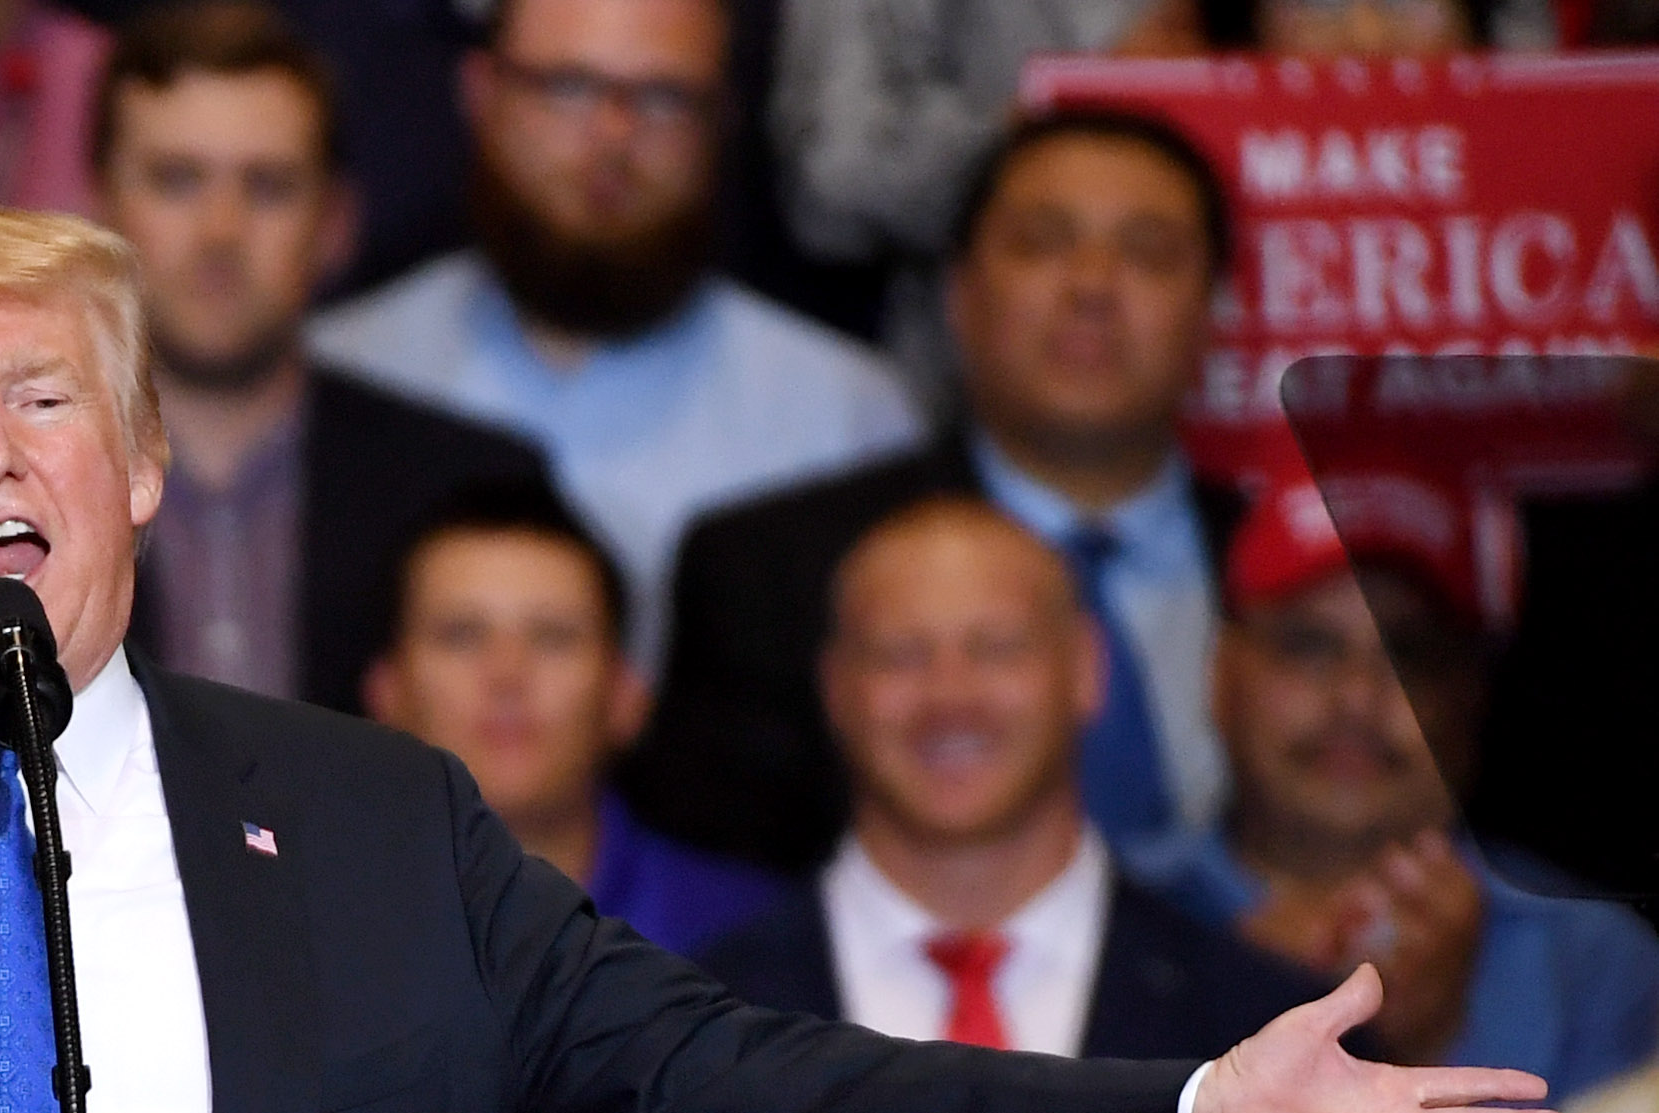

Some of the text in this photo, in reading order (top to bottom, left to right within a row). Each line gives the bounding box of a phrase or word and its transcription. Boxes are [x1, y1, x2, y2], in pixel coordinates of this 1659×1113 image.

[1240, 126, 1464, 198] MAKE
[1214, 212, 1659, 328] ERICA
[1200, 346, 1356, 420] EAT
